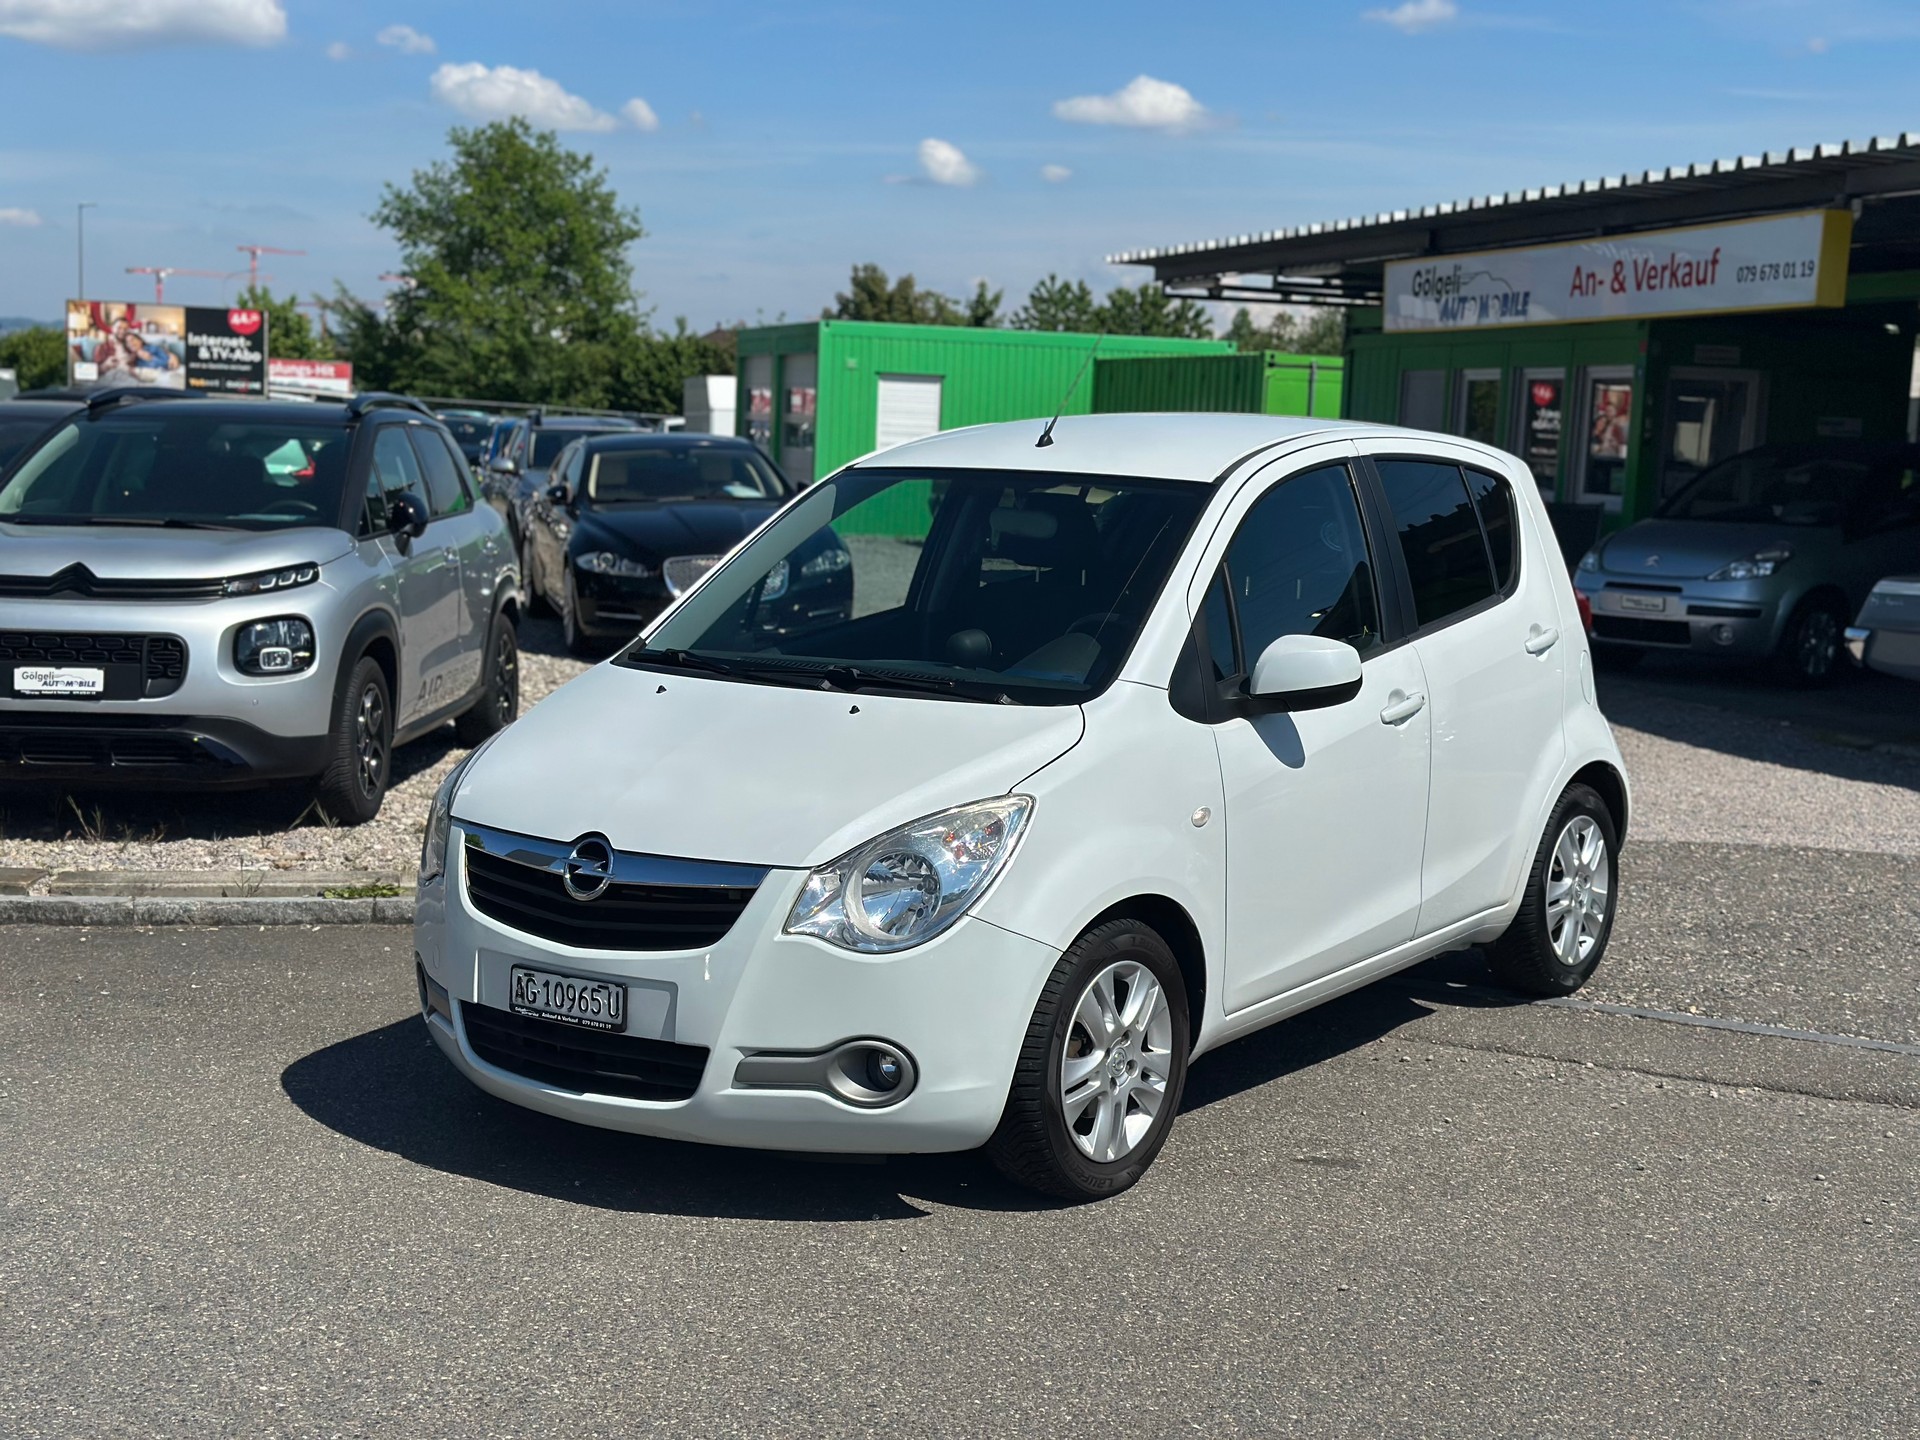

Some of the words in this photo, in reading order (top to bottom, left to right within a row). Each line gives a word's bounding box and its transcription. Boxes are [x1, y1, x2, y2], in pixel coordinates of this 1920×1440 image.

[1412, 264, 1462, 303] Gölgeli
[1570, 265, 1604, 298] An-
[1610, 260, 1627, 295] &
[1633, 248, 1721, 293] Verkauf
[1736, 264, 1758, 284] 079
[1759, 262, 1780, 282] 678
[1783, 261, 1797, 280] 01
[1800, 259, 1815, 278] 19
[187, 332, 252, 348] Internet-
[21, 671, 55, 682] Gölgeli
